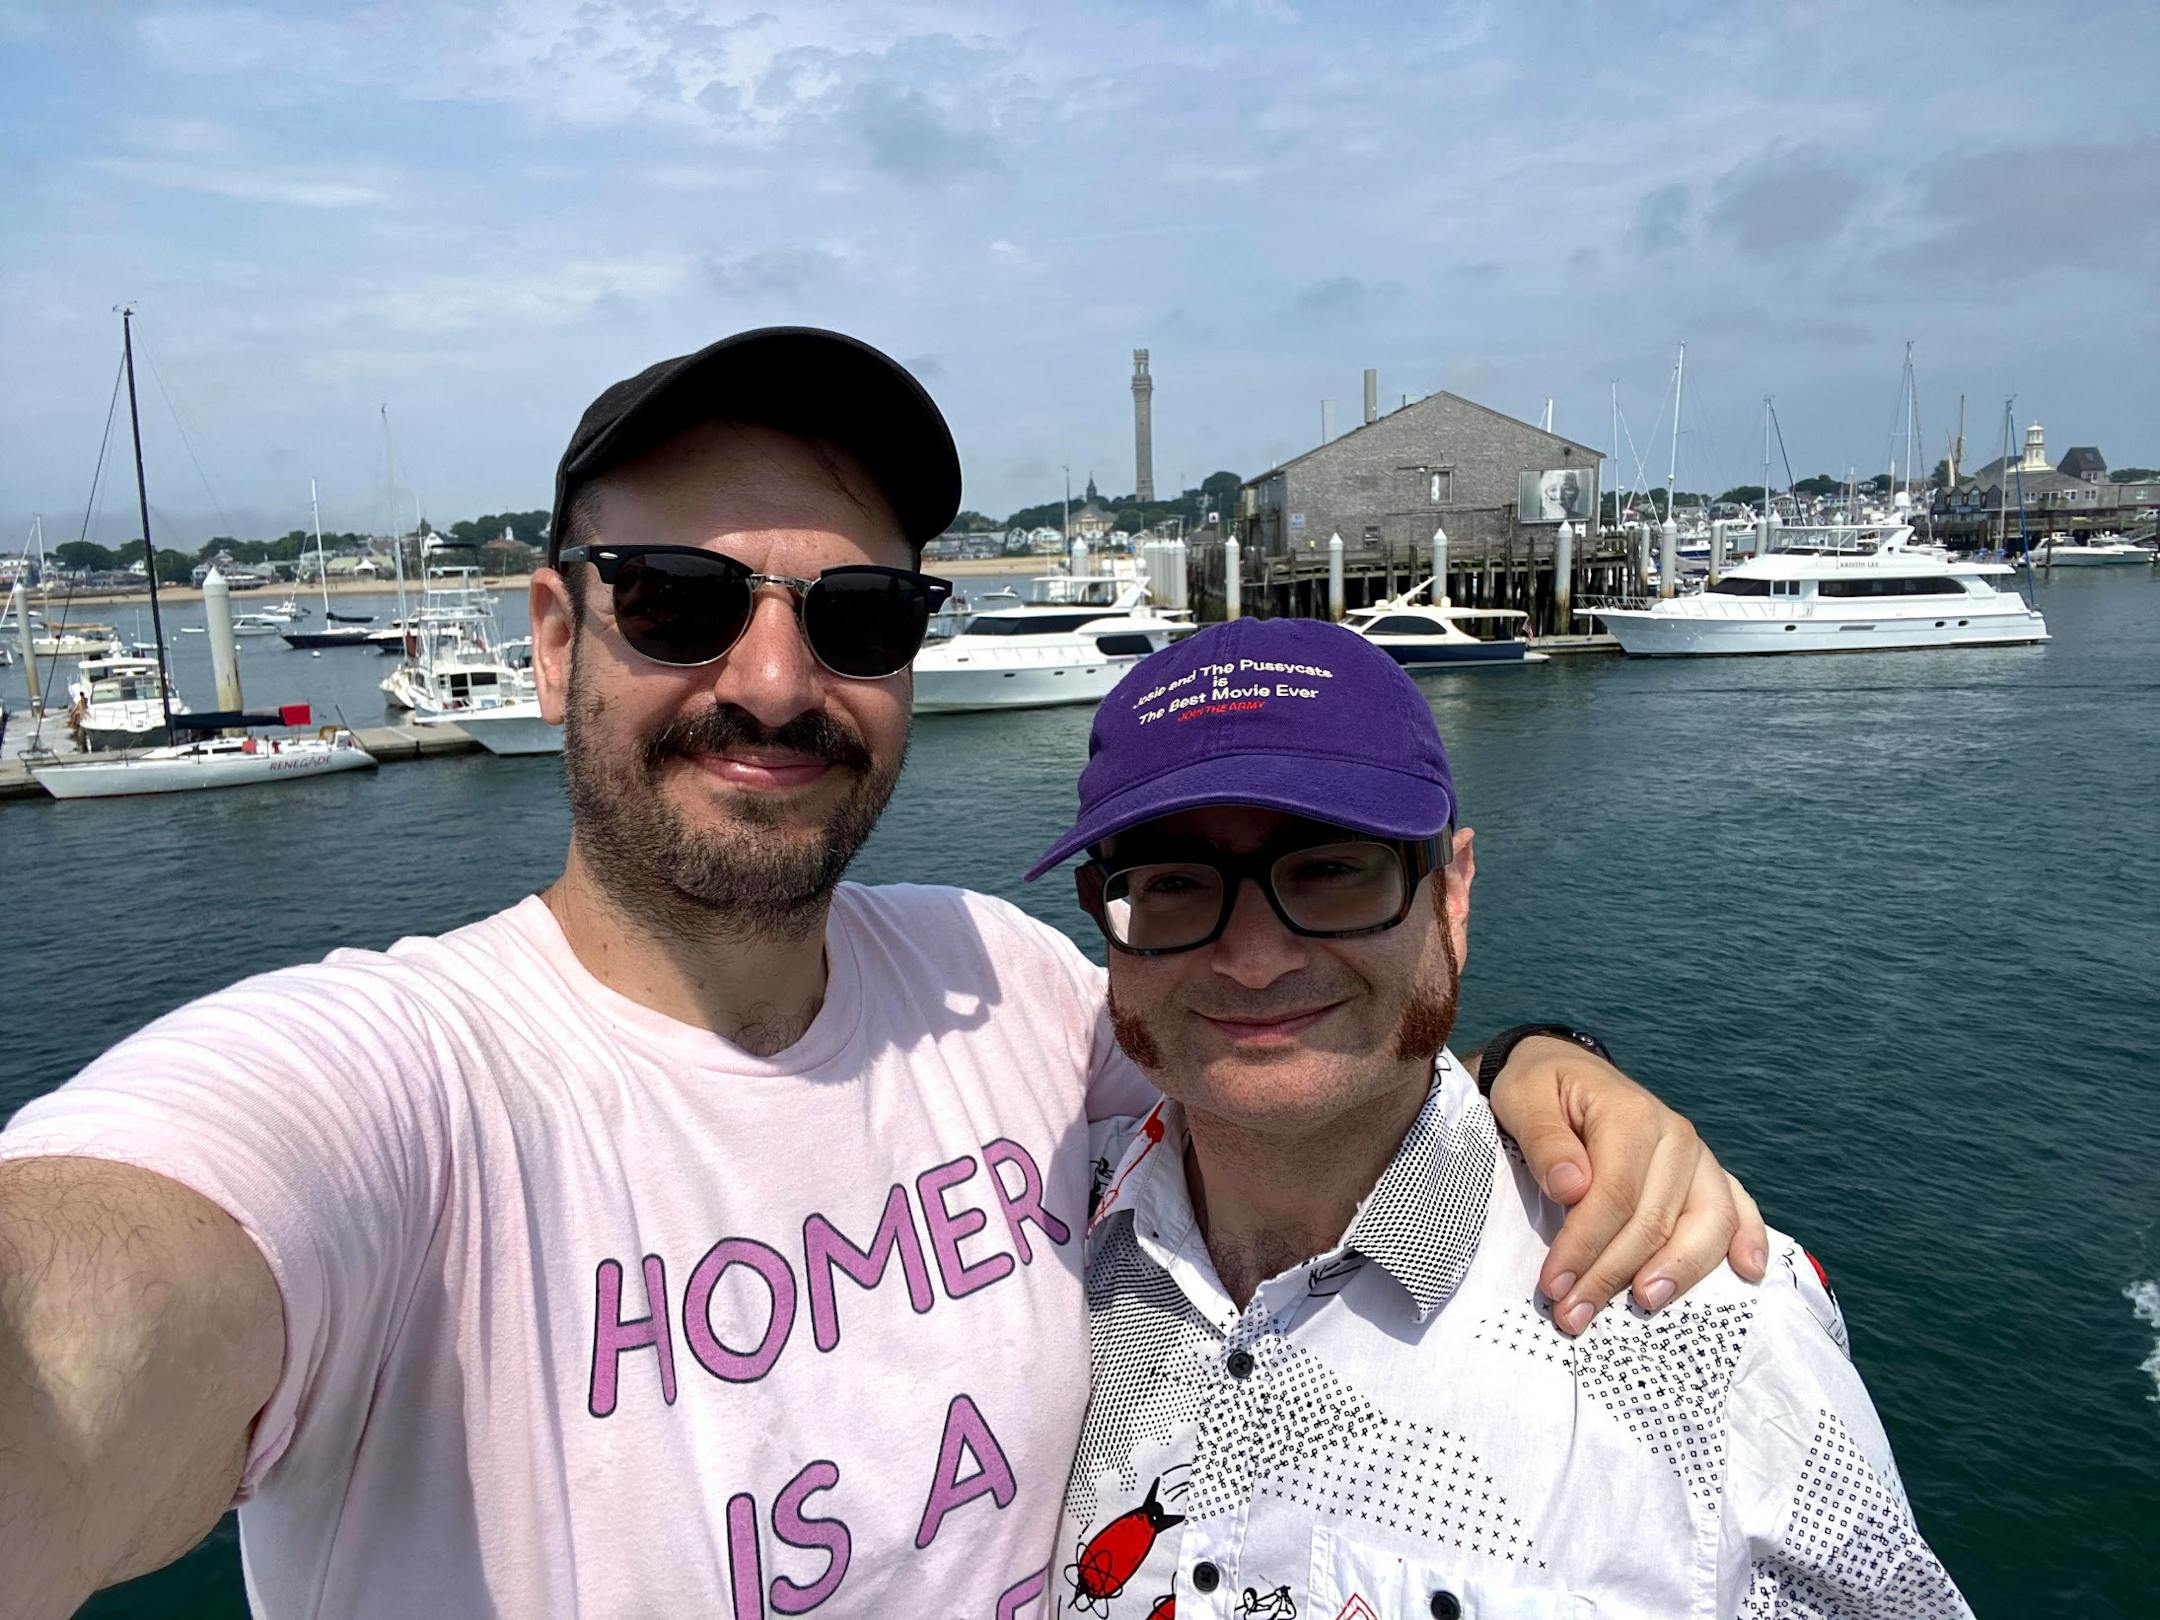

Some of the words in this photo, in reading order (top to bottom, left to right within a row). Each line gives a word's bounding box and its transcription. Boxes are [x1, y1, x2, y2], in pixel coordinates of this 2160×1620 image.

[1133, 686, 1166, 709] Josie
[1168, 669, 1197, 691] and
[1200, 663, 1235, 676] The
[1240, 659, 1333, 678] Pussycats
[1212, 675, 1229, 687] is
[1139, 708, 1166, 725] The
[1168, 692, 1207, 712] Best
[1212, 683, 1271, 701] Movie
[1276, 684, 1319, 699] Ever
[1178, 708, 1204, 722] JOIN
[1206, 703, 1228, 714] THE
[1229, 701, 1266, 712] ARMY
[270, 755, 332, 771] RENEGADE
[588, 1137, 1071, 1418] HOMER
[726, 1459, 852, 1620] IS
[915, 1393, 1017, 1549] A
